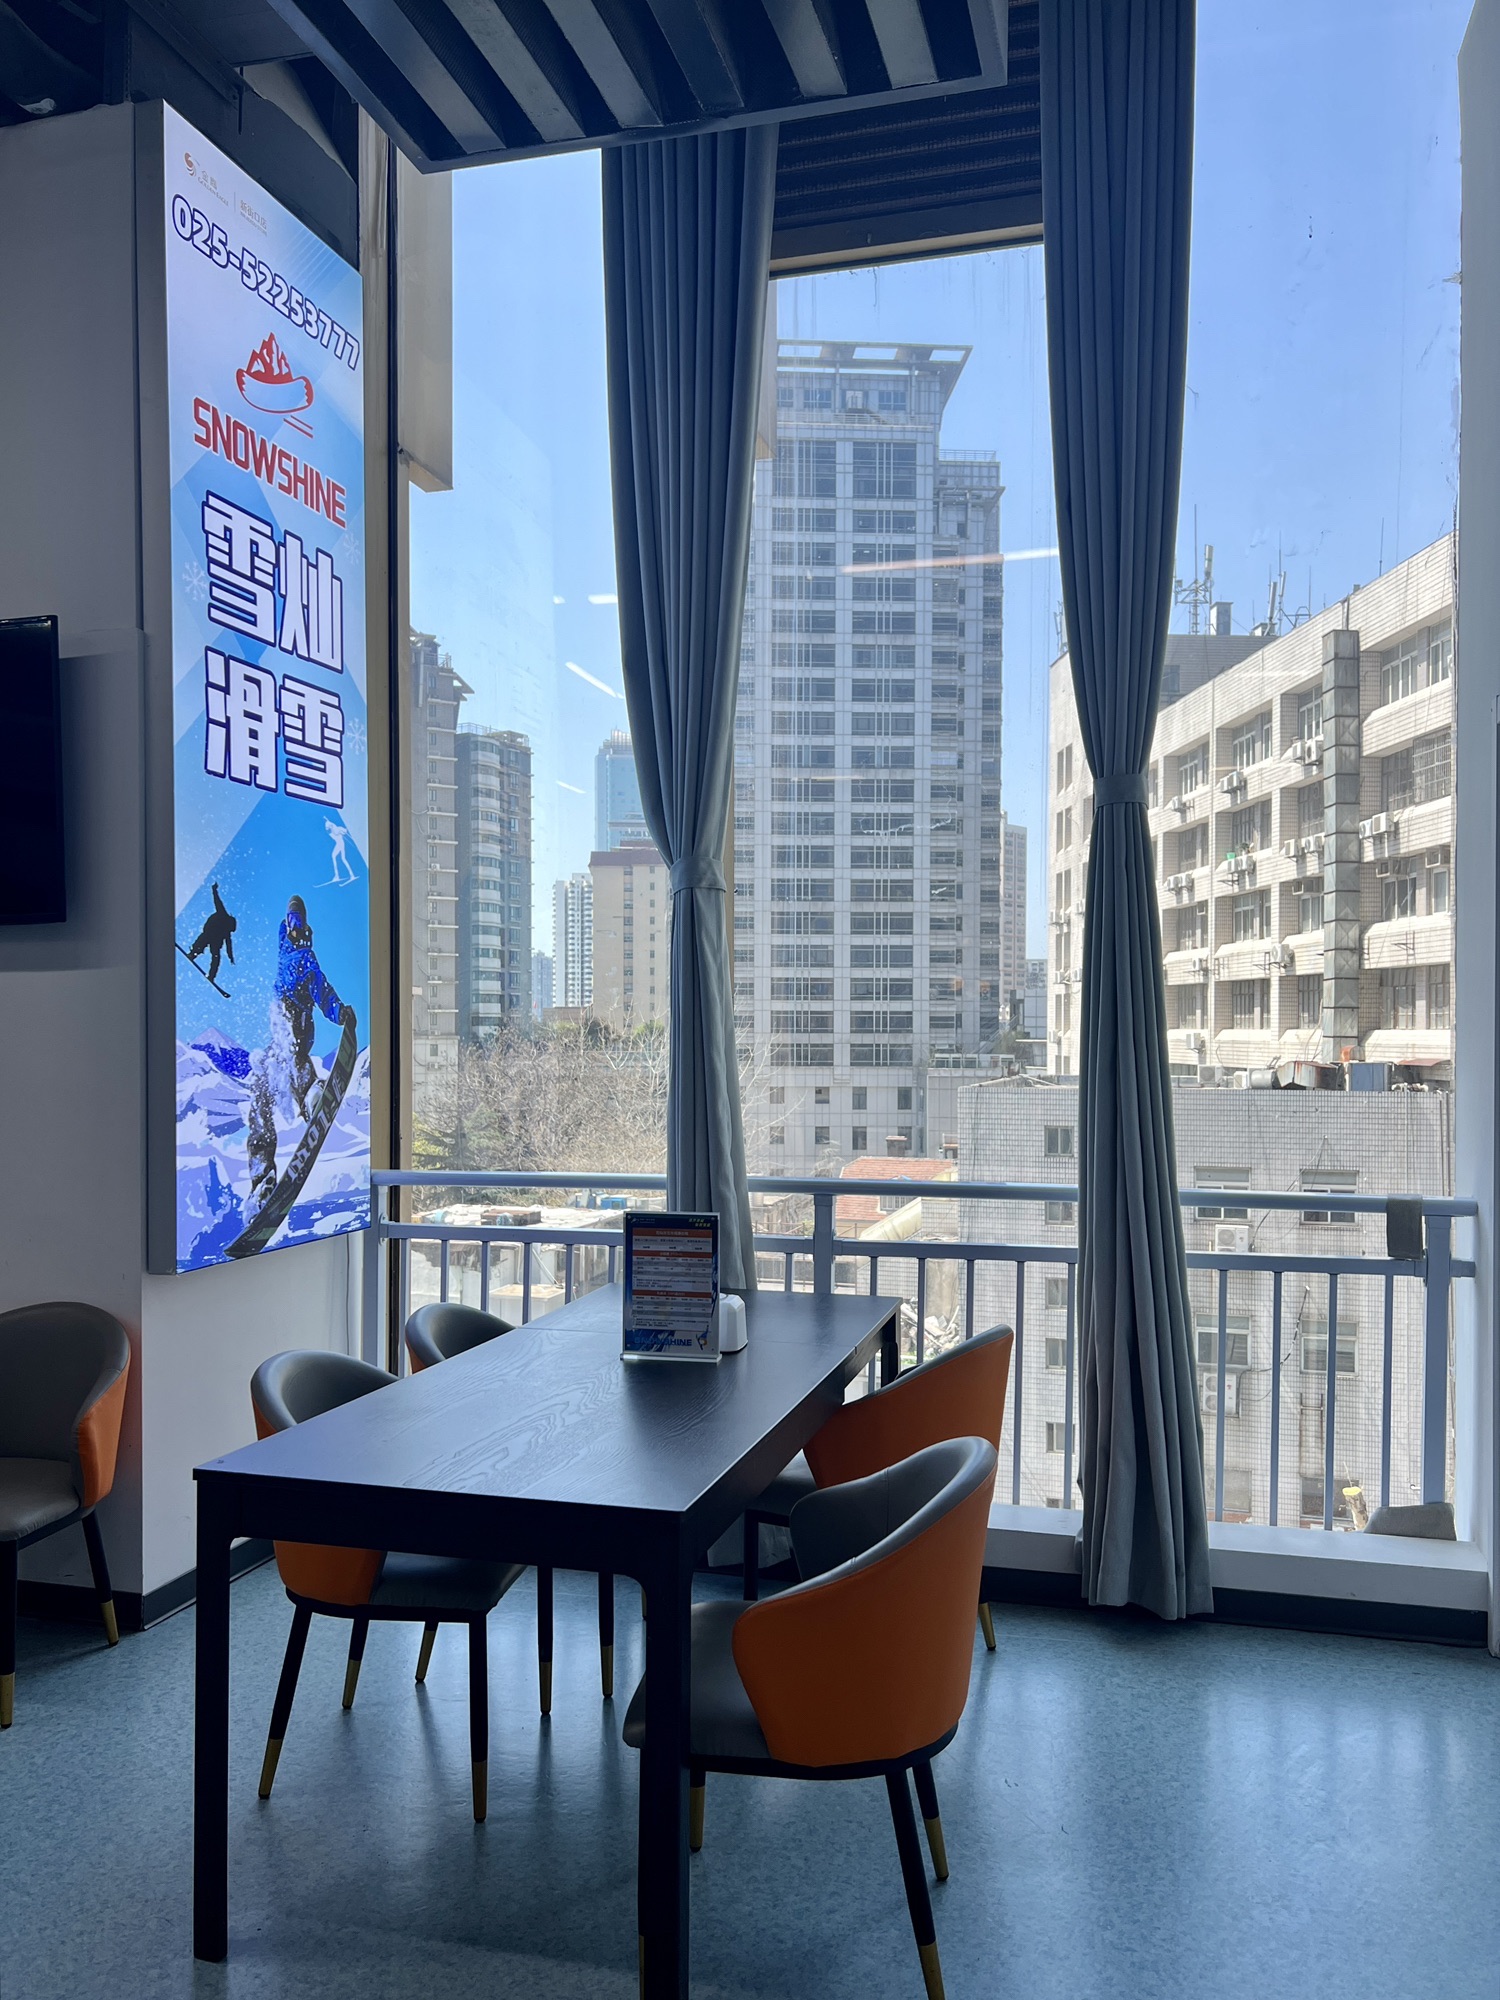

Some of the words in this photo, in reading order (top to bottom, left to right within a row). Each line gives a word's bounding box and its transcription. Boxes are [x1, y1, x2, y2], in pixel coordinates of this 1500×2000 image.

[172, 194, 360, 371] 025-52253777
[193, 396, 347, 529] SNOWSHINE
[202, 490, 344, 674] 雪灿
[204, 645, 344, 809] 滑雪
